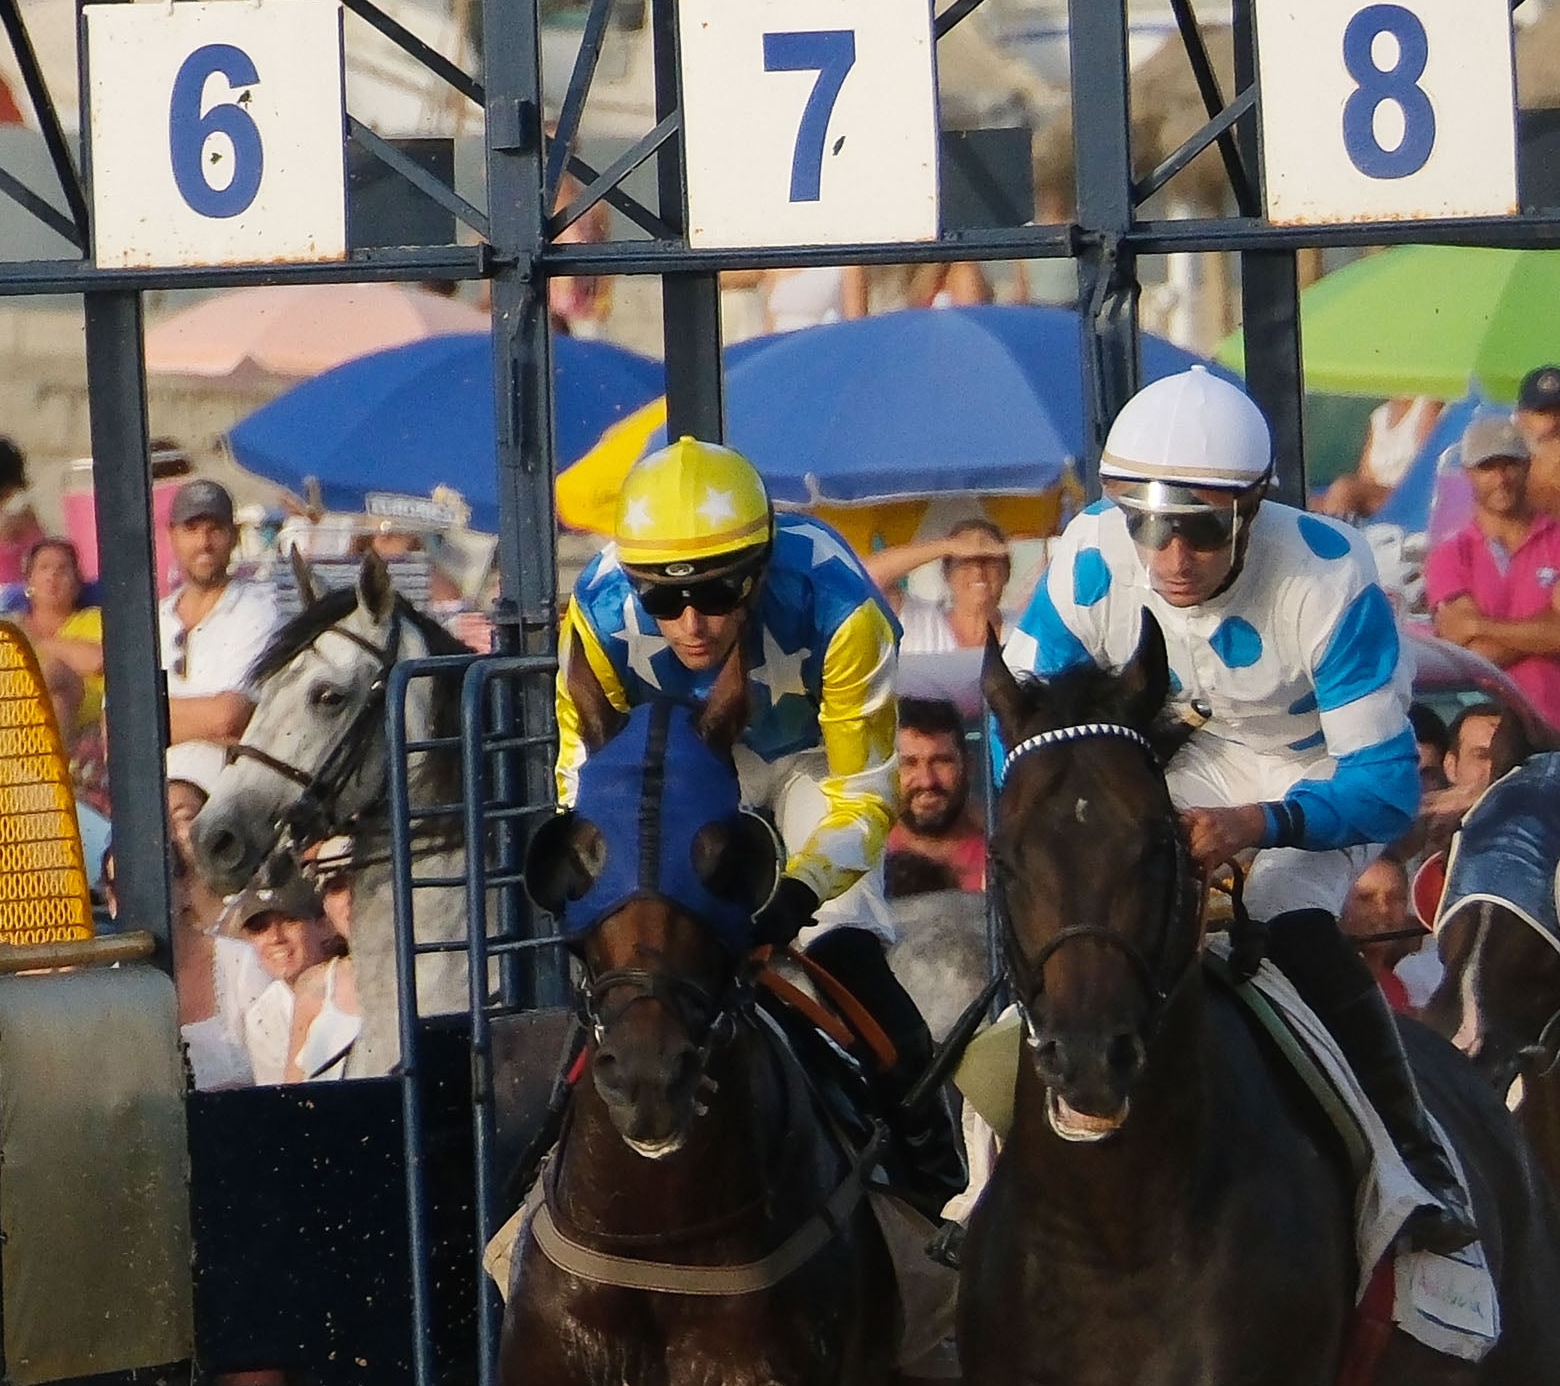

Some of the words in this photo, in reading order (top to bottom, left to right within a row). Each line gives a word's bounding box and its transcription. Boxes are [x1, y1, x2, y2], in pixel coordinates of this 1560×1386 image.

[168, 43, 266, 220] 6
[763, 29, 857, 203] 7
[1342, 3, 1438, 180] 8
